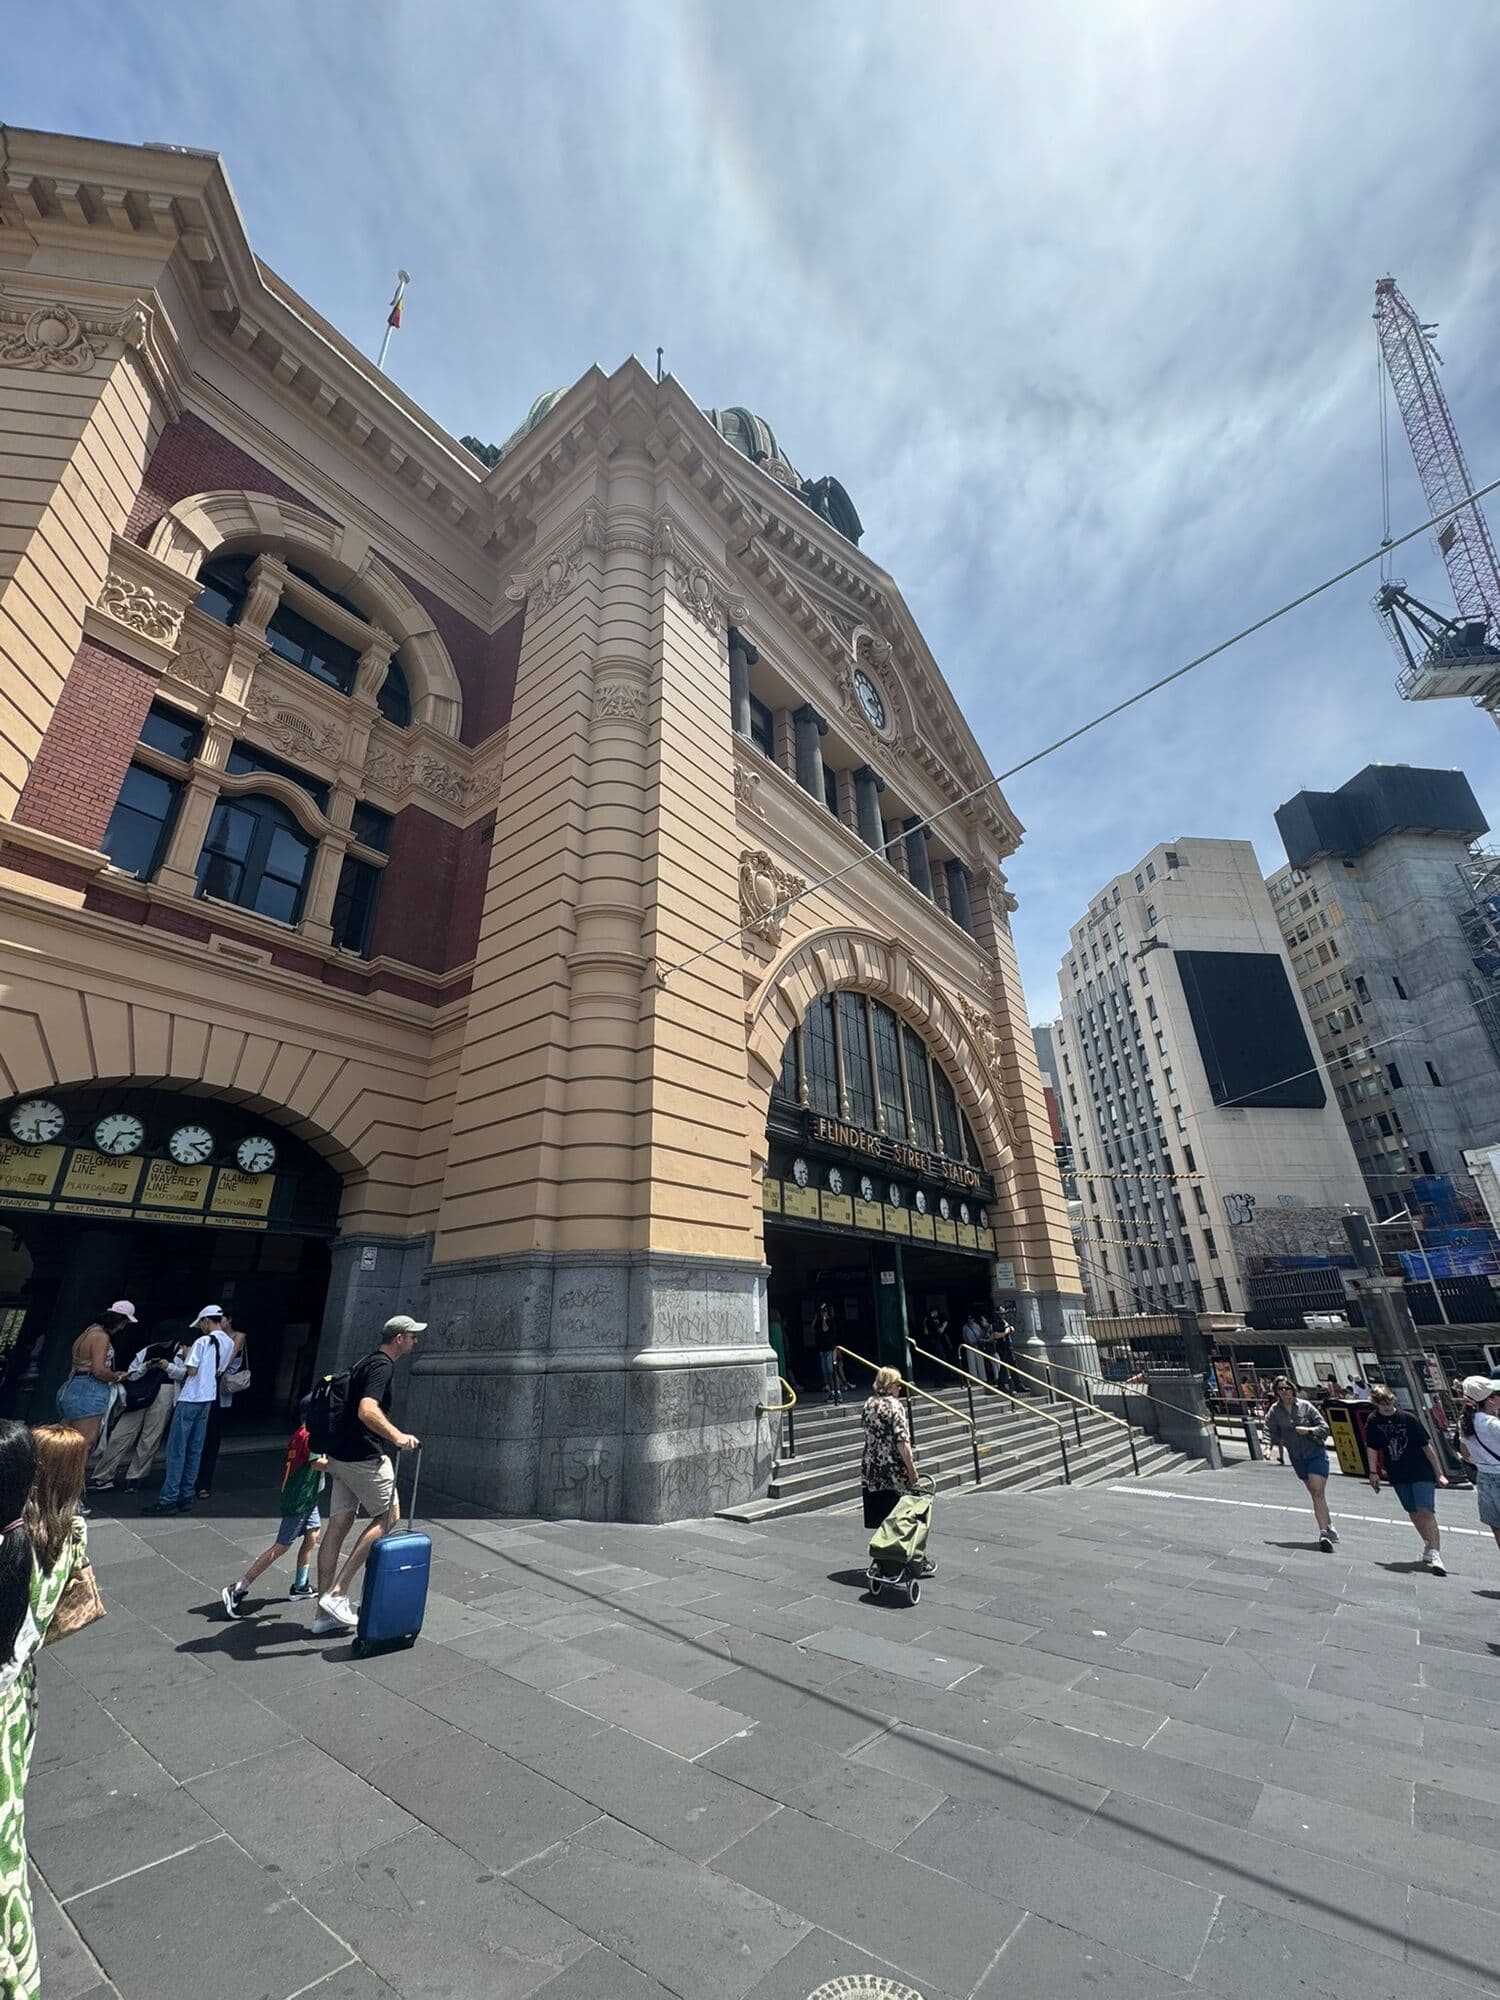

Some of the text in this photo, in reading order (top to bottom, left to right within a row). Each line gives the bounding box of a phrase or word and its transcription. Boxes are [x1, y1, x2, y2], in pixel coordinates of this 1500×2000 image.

[819, 1117, 981, 1187] FLINDERS STREET STATION
[74, 1153, 131, 1169] BELGRAVE
[71, 1163, 97, 1175] LINE
[152, 1164, 179, 1174] GLEN
[150, 1173, 202, 1187] WAVERLEY
[220, 1173, 259, 1185] ALAMEIN
[66, 1182, 109, 1193] PLATFORM
[146, 1182, 170, 1193] LINE
[218, 1181, 238, 1192] LINE
[144, 1191, 183, 1201] PLATFORM
[215, 1197, 249, 1206] PLATFORM
[65, 1204, 84, 1212] NEXT
